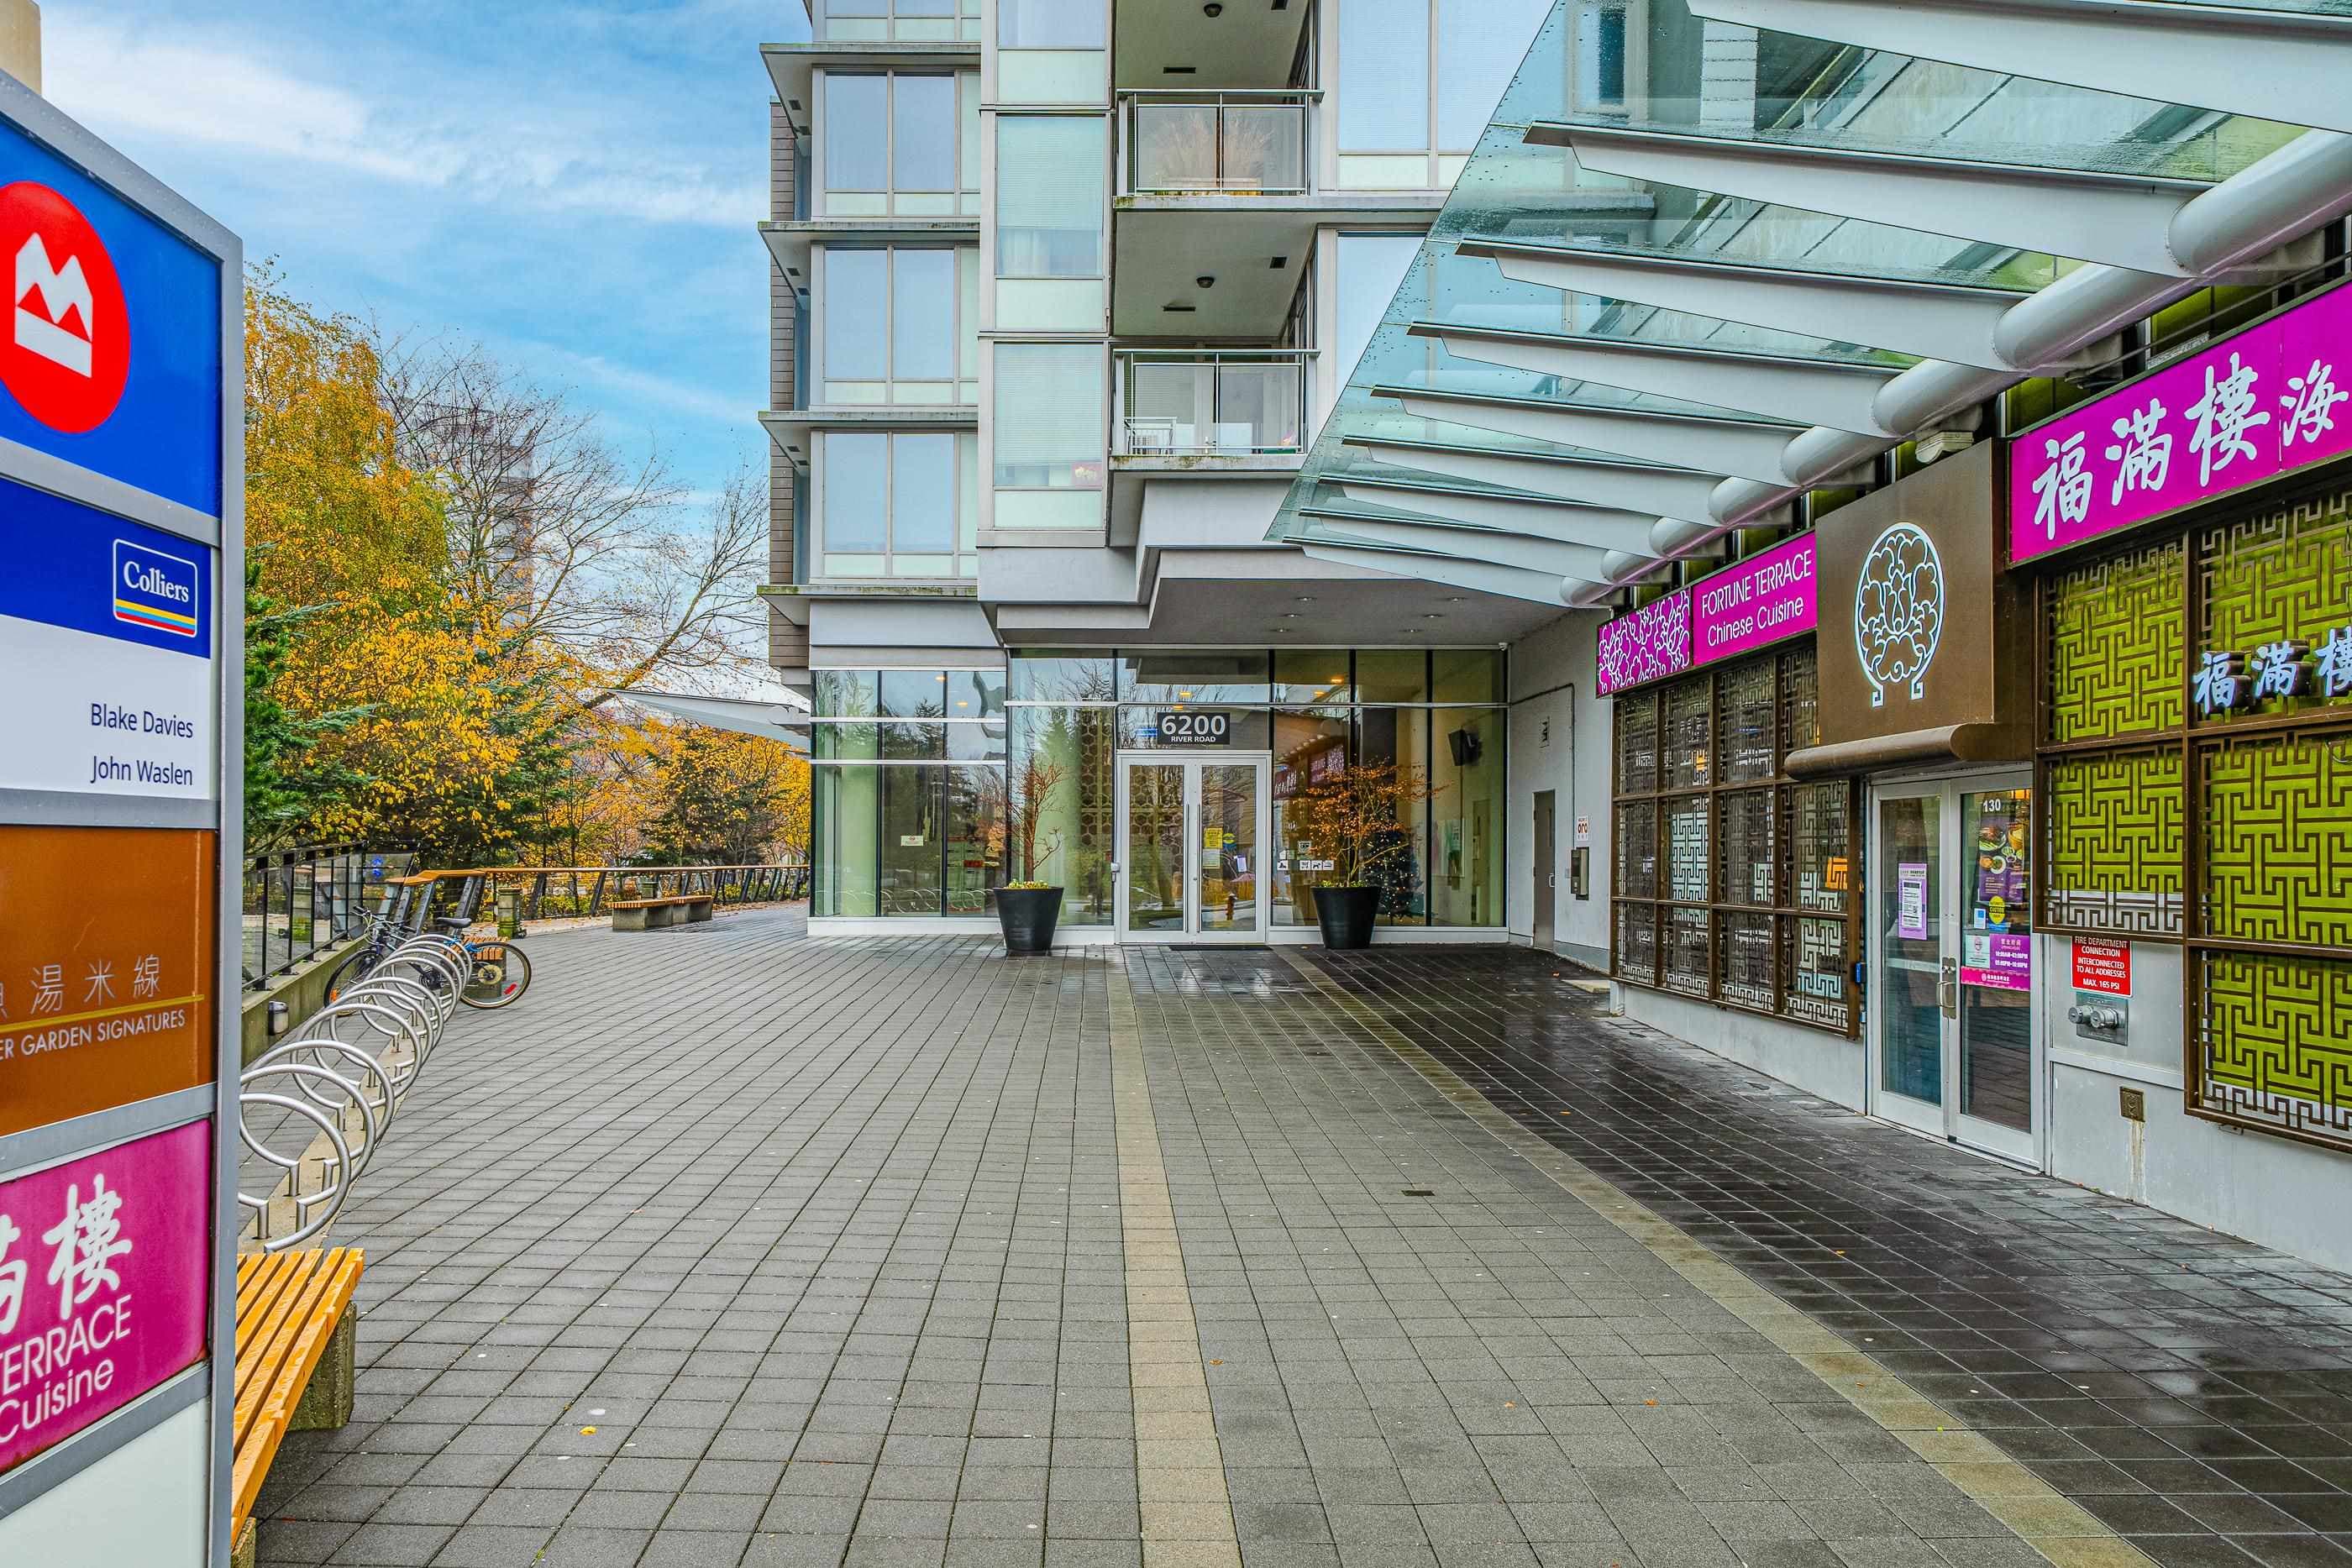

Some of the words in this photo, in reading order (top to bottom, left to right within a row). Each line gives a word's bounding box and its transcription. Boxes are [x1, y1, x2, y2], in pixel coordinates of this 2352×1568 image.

[123, 560, 190, 603] Colliers
[1701, 575, 1751, 619] FORTUNE
[1754, 548, 1812, 598] TERRACE
[1708, 616, 1754, 647] Chinese
[1756, 595, 1804, 630] Cuisine
[91, 702, 138, 732] Blake
[143, 710, 194, 739] Davies
[1162, 715, 1226, 736] 6200
[89, 754, 132, 784] John
[136, 758, 193, 787] Waslen
[1982, 798, 2001, 813] 130
[2075, 936, 2087, 945] FIRE
[2088, 937, 2129, 948] DEPARTMENT
[2082, 946, 2121, 957] CONNECTION
[2076, 965, 2084, 973] TO
[2085, 966, 2094, 974] ALL
[2095, 968, 2126, 978] ADDRESSES
[2077, 957, 2125, 969] INTERCONNECTED
[2083, 978, 2097, 987] MAX.
[2110, 982, 2120, 990] PSI
[21, 1025, 92, 1056] GARDEN
[97, 1009, 186, 1042] SIGNATURES
[0, 1294, 132, 1395] ERRACE
